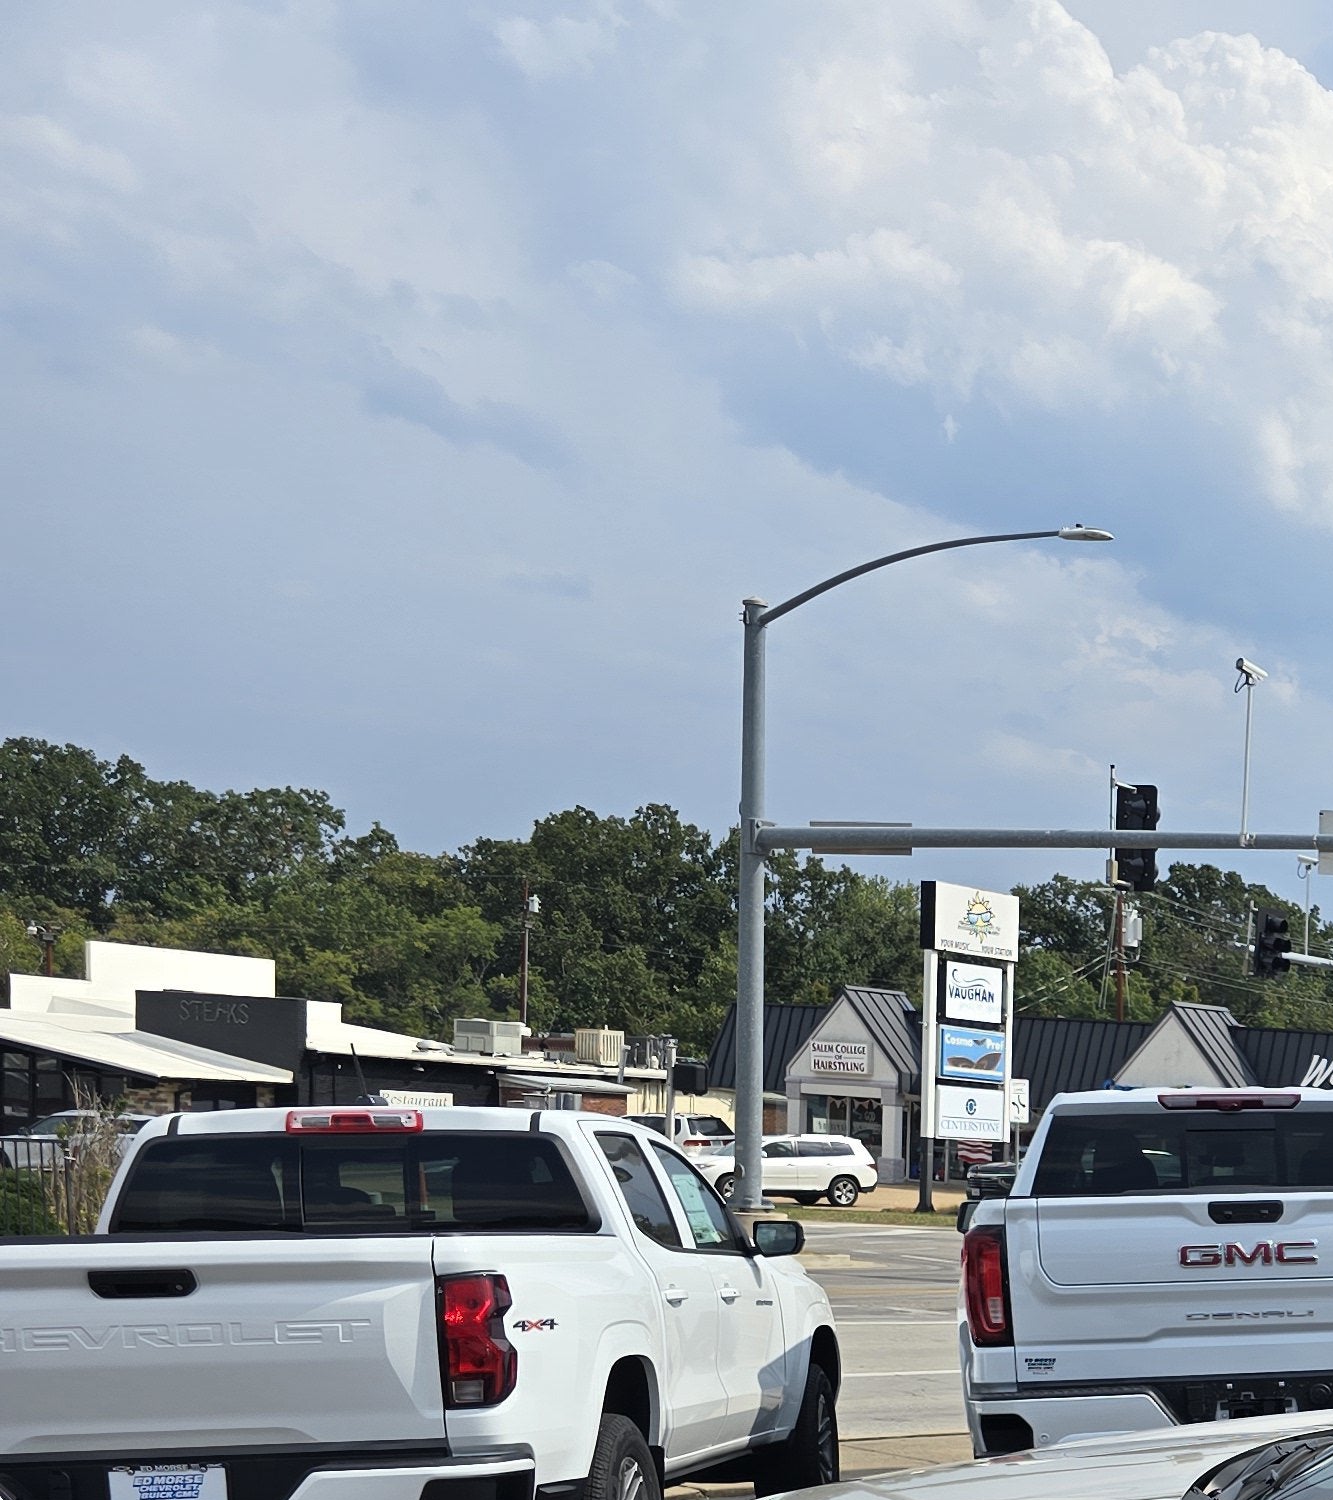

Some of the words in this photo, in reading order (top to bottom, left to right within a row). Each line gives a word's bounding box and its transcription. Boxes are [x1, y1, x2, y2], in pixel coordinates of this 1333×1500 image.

[948, 984, 994, 1003] VAUGHAN
[180, 1000, 249, 1024] STEAKS
[944, 1033, 973, 1047] Cosmo
[812, 1042, 833, 1053] SALEM
[835, 1044, 866, 1055] COLLEGE
[813, 1059, 865, 1072] HAIRSTYLING
[940, 1120, 1001, 1133] CENTERSTONE
[1178, 1239, 1319, 1267] GMC
[1186, 1309, 1314, 1321] DENALI
[0, 1318, 372, 1352] EVROLET
[154, 1463, 189, 1472] MORSE
[133, 1476, 153, 1487] ED
[153, 1474, 204, 1486] MORSE
[139, 1484, 200, 1493] CHEVROLET
